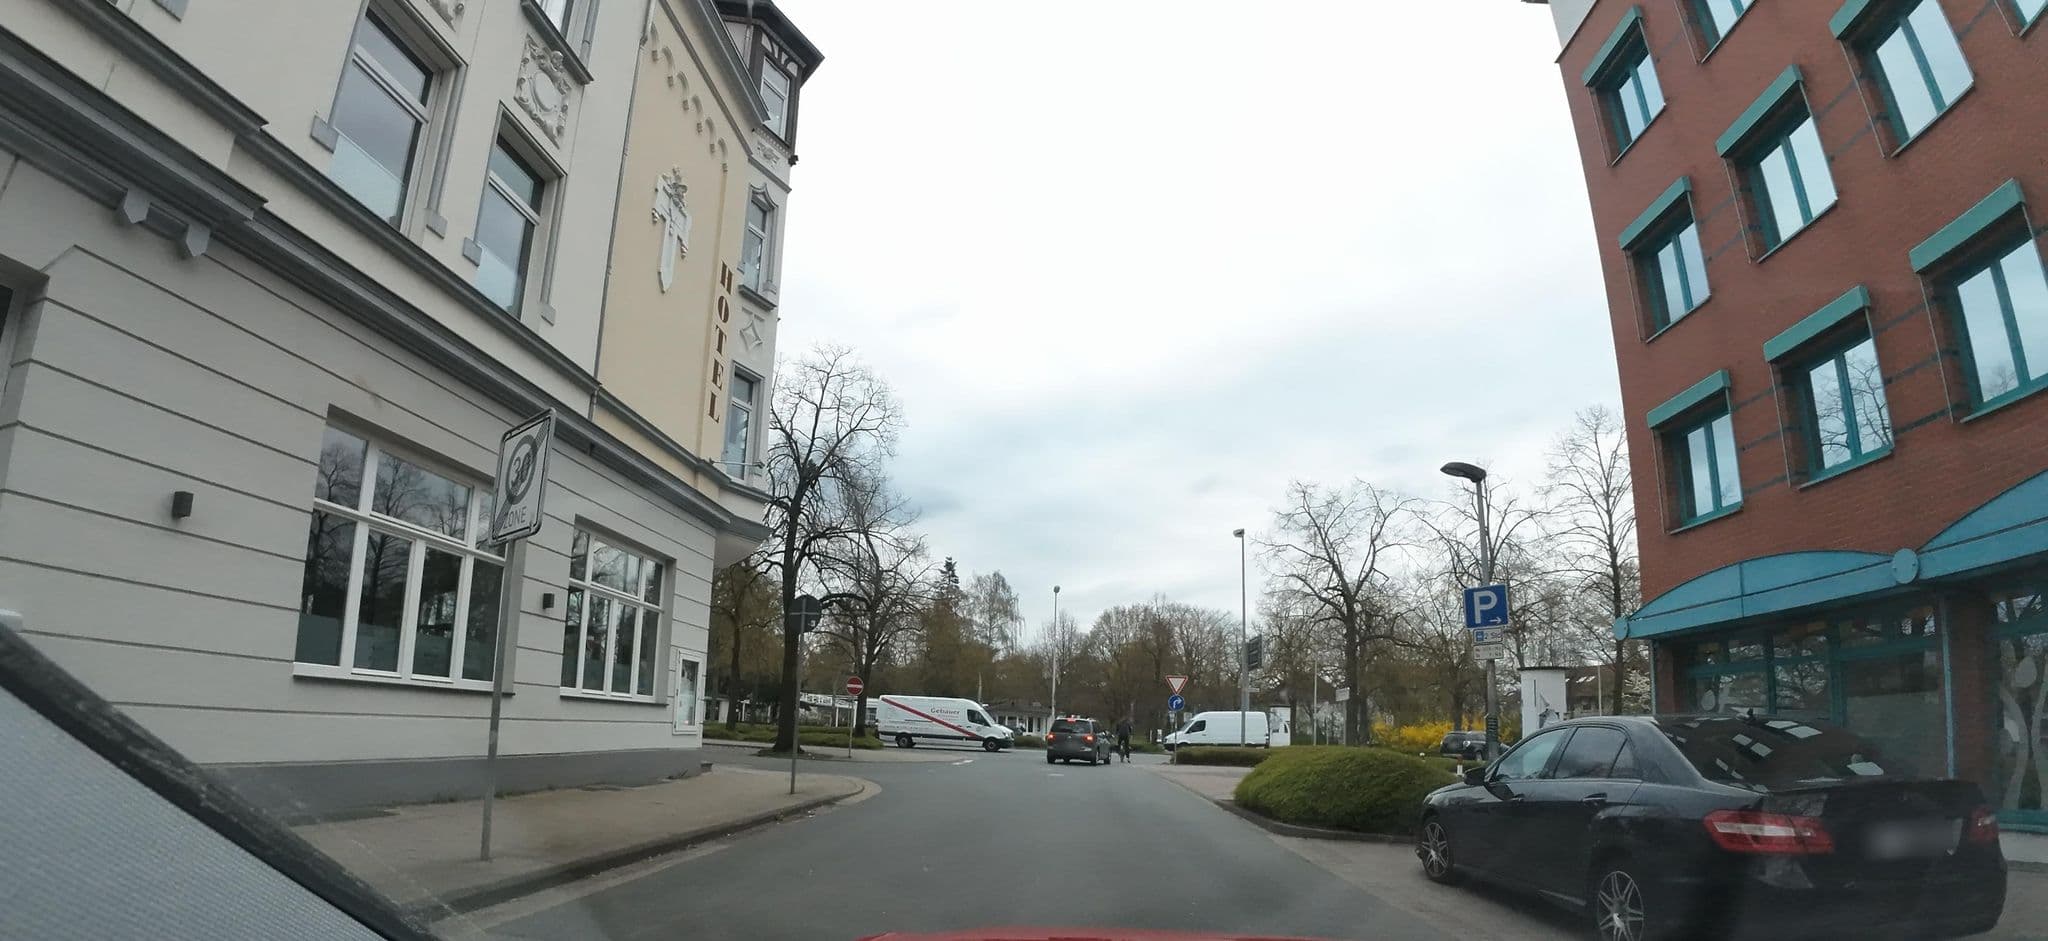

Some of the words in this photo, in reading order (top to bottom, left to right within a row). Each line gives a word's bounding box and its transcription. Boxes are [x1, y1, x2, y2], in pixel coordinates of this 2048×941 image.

[708, 260, 734, 424] HOTEL
[511, 452, 533, 488] 30
[502, 505, 527, 530] ZONE
[1473, 590, 1498, 624] P
